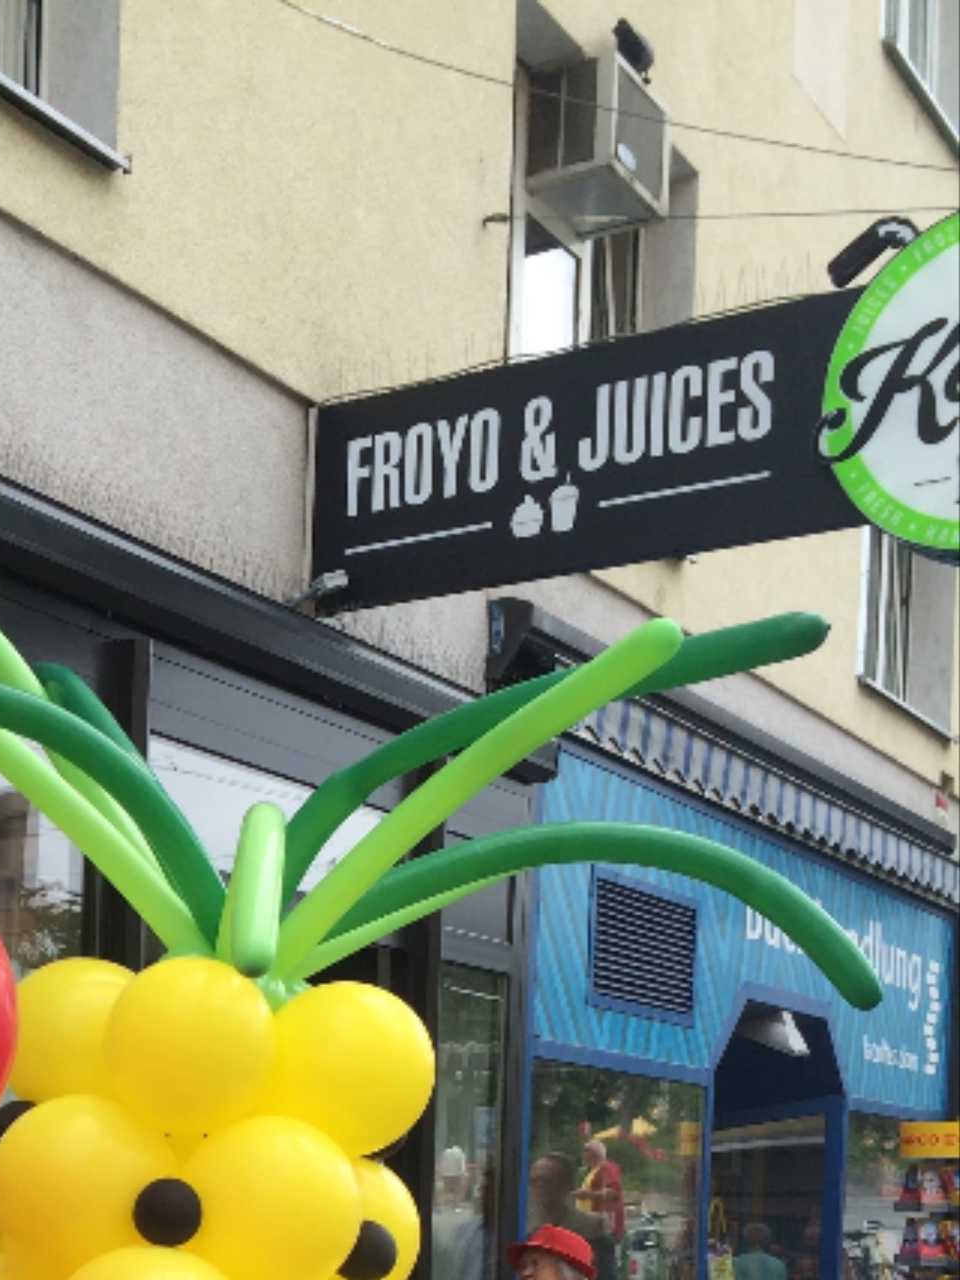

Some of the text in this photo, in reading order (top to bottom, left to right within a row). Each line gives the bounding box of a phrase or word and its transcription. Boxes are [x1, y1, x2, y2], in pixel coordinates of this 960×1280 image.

[346, 350, 776, 518] FROYO & JUICES
